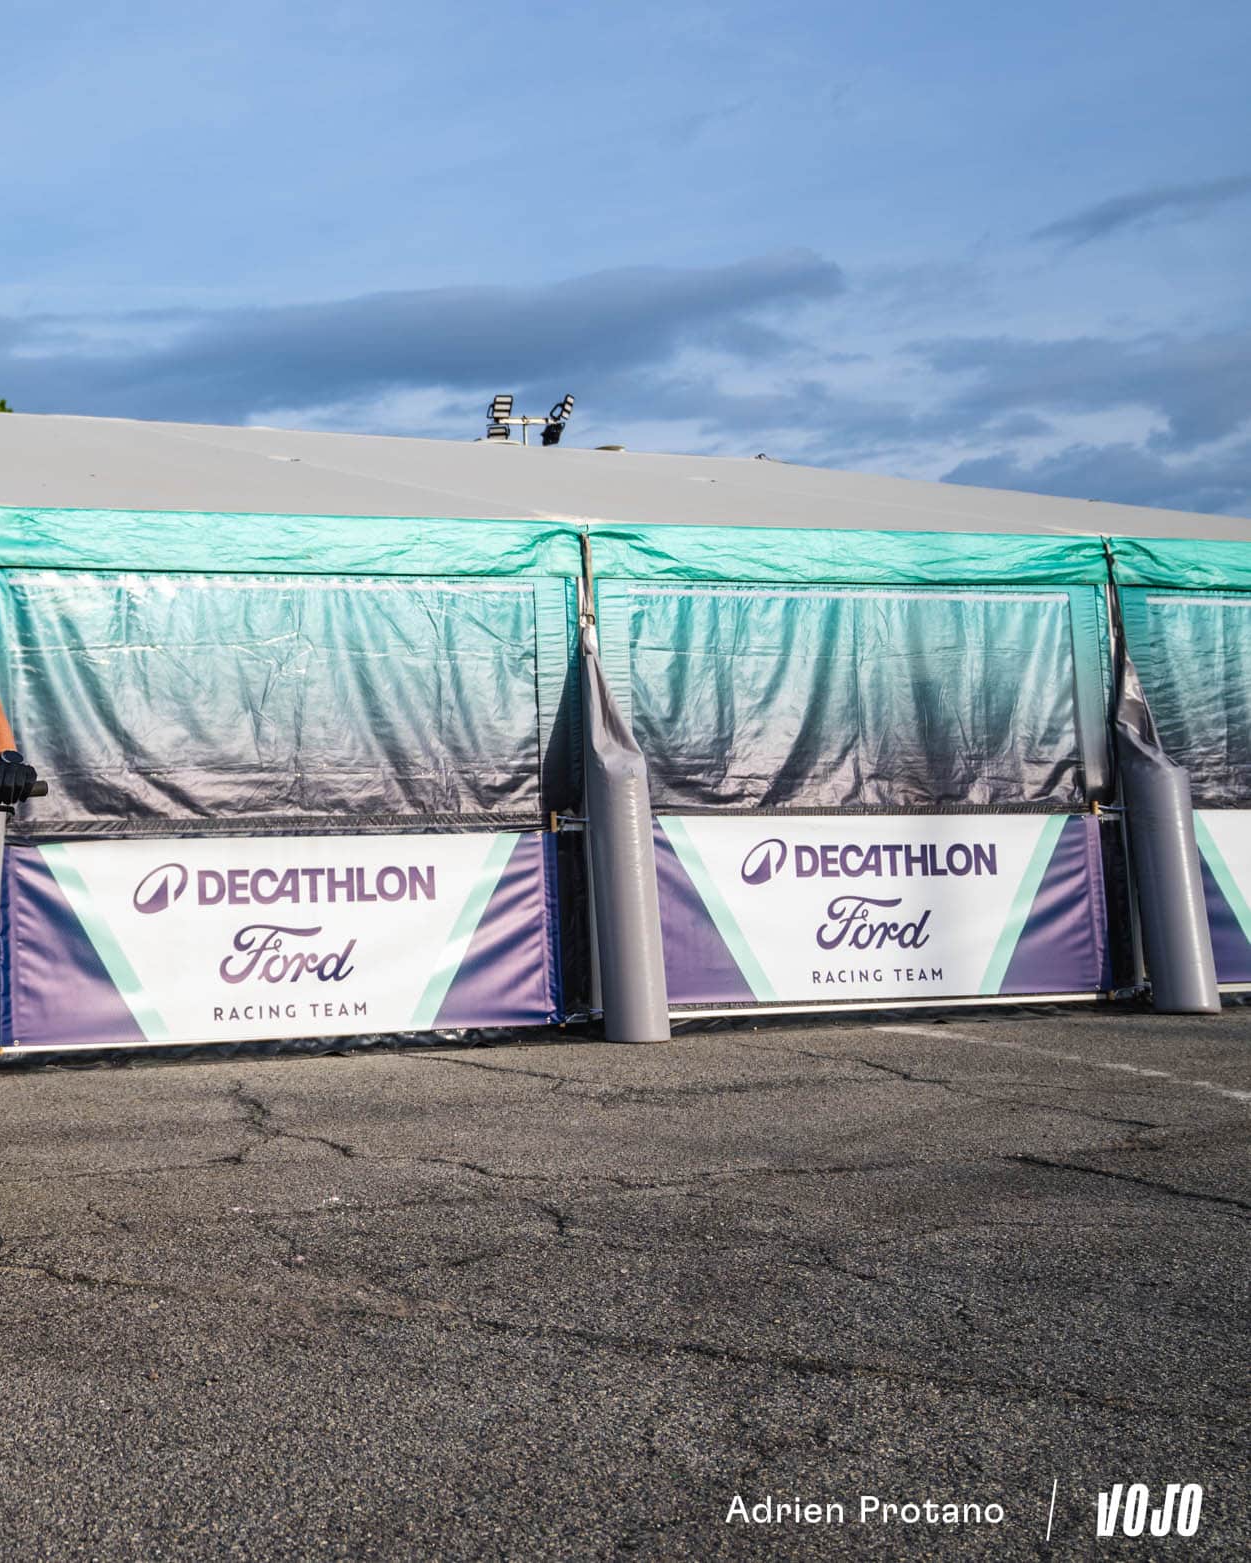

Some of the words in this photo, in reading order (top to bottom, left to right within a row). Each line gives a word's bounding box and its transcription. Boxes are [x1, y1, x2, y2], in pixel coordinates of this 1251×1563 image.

[794, 843, 998, 878] DECATHLON
[197, 866, 437, 906] DECATHLON
[816, 895, 932, 950] Ford
[219, 924, 357, 984] Ford
[812, 969, 883, 984] RACING
[894, 968, 943, 981] TEAM
[213, 1004, 297, 1021] RACING
[310, 1002, 367, 1016] TEAM
